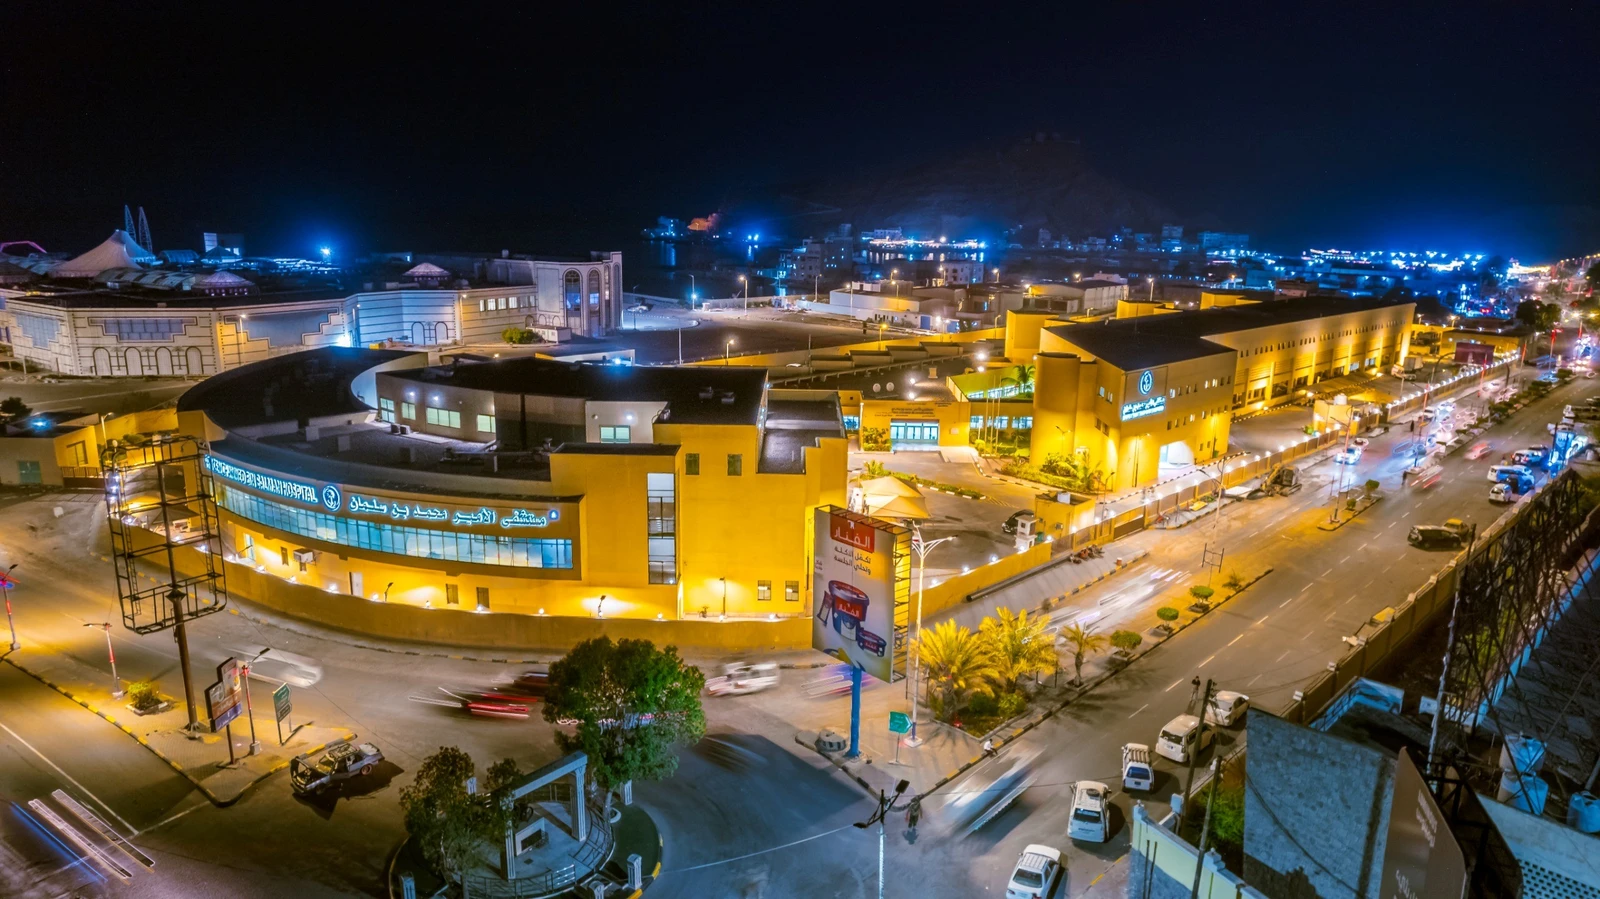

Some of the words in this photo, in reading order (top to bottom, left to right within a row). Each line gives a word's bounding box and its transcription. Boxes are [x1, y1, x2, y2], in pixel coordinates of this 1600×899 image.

[282, 481, 318, 503] HOSPITAL
[350, 496, 387, 513] سلمان
[391, 503, 409, 519] بن
[413, 505, 448, 519] محمد
[452, 508, 496, 525] الأمير
[501, 509, 547, 528] مستشفى
[835, 527, 870, 549] الفنار
